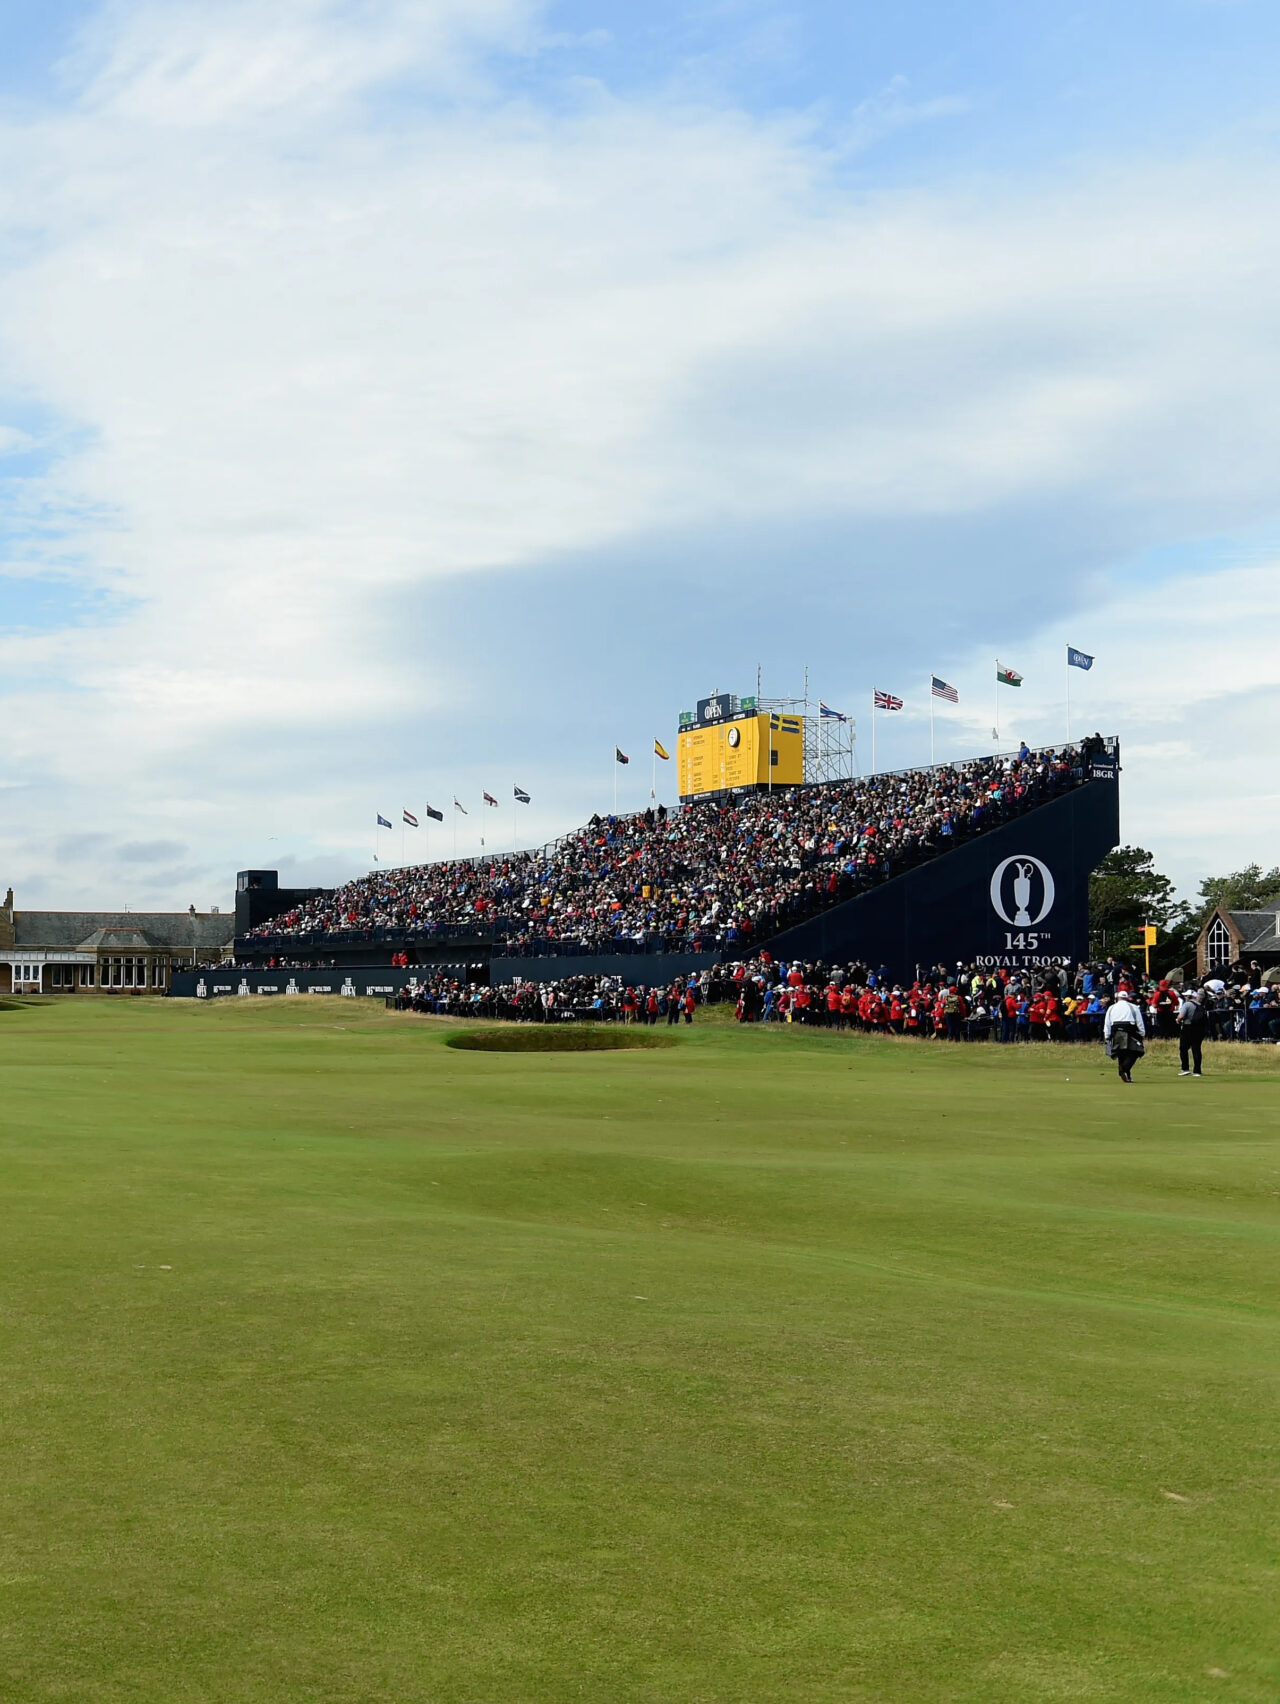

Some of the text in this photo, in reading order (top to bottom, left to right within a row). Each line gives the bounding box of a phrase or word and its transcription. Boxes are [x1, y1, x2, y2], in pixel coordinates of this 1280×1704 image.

[704, 704, 722, 719] OPEN
[1093, 769, 1115, 779] 18GR
[976, 955, 1072, 967] ROYAL TROON
